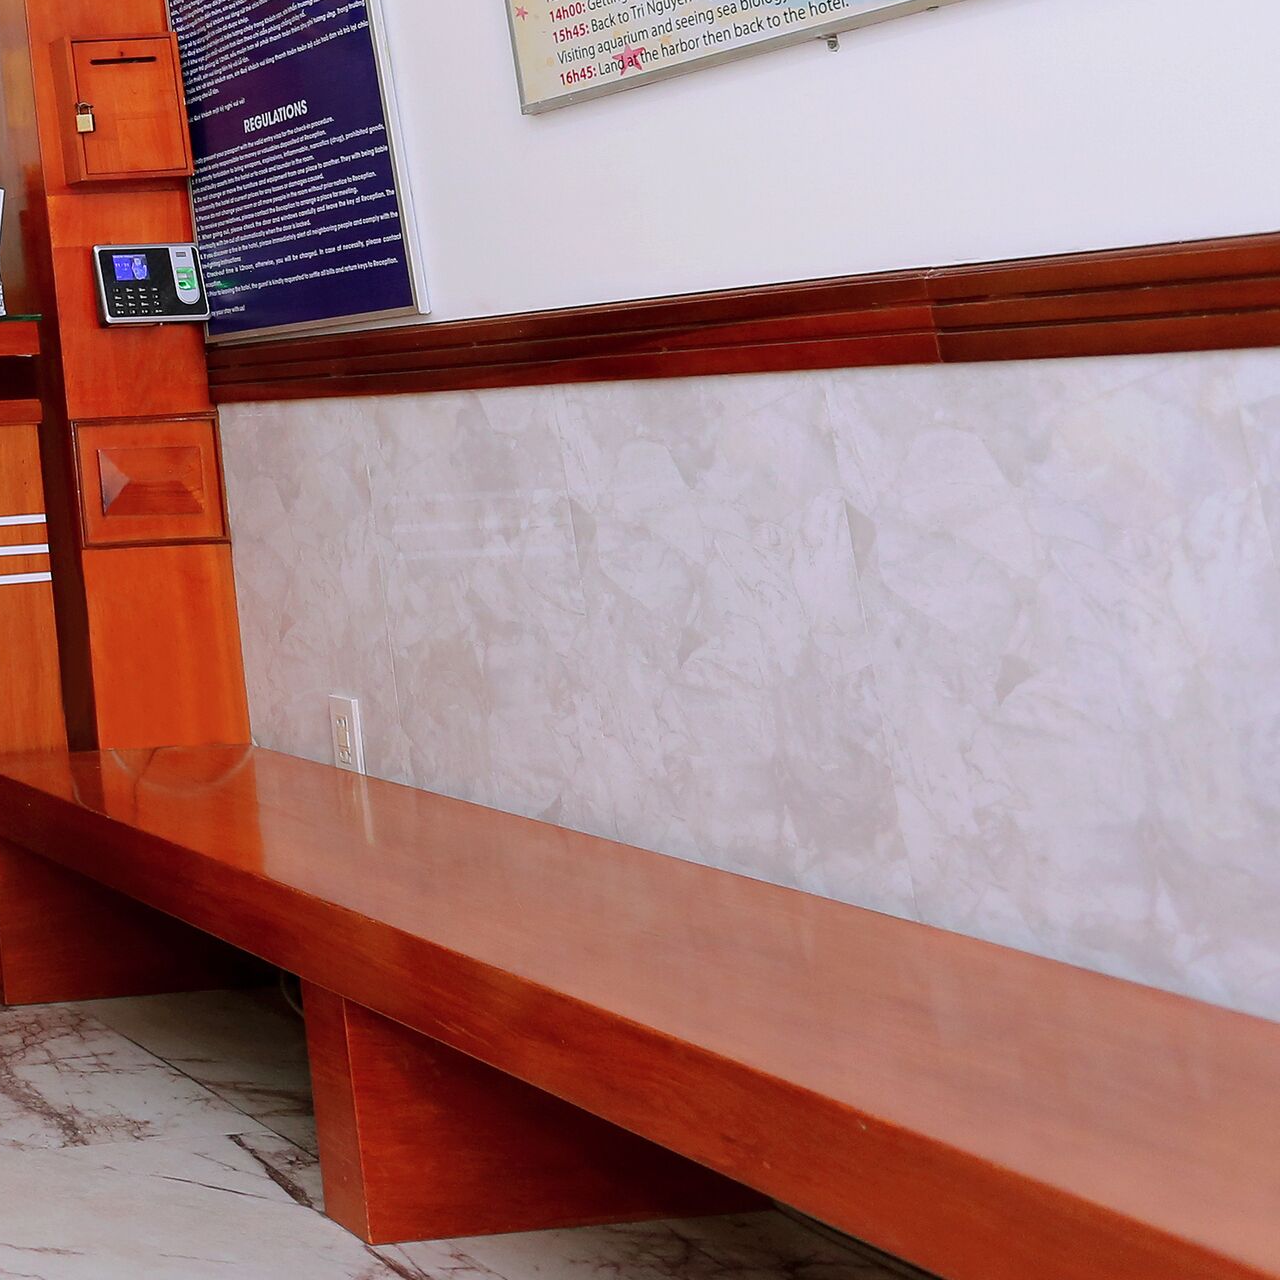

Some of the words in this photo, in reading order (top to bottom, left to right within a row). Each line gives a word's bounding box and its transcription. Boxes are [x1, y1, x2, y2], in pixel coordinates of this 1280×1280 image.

[559, 65, 597, 85] 16h45:
[598, 56, 626, 75] Land
[627, 53, 638, 67] at
[639, 48, 659, 63] the
[660, 37, 699, 57] harbor
[702, 29, 731, 46] then
[733, 16, 765, 37] back
[766, 15, 781, 28] to
[782, 7, 806, 24] the
[243, 99, 308, 134] REGULATIONS
